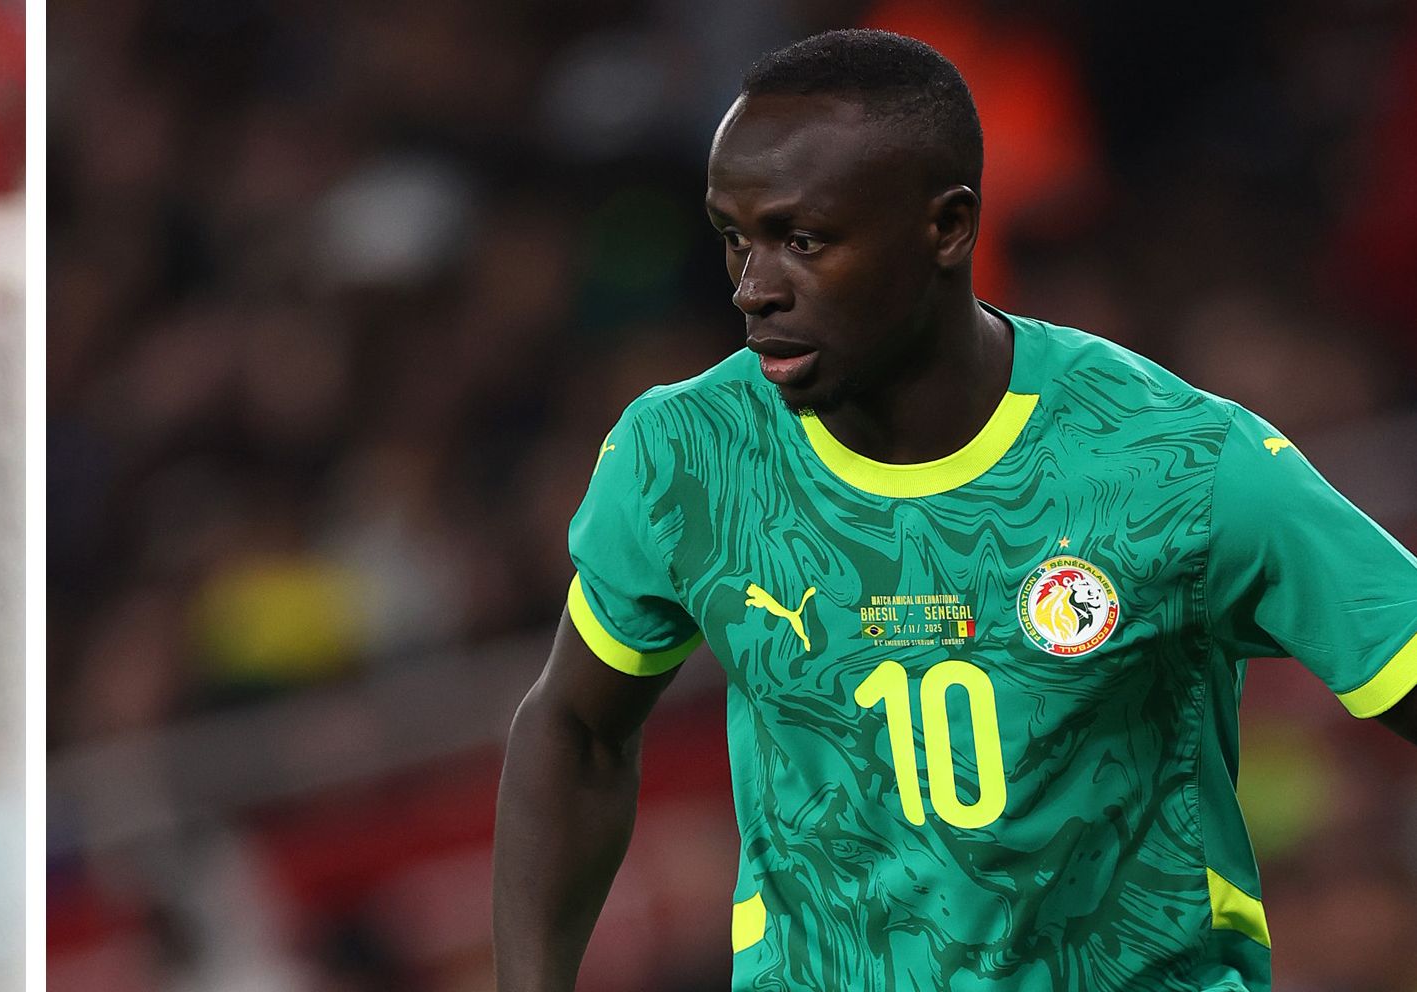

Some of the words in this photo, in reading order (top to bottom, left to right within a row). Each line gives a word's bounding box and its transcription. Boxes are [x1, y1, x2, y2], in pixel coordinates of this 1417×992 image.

[860, 607, 898, 621] BRESIL
[924, 605, 973, 620] SENEGAL
[1107, 611, 1116, 625] DE
[1059, 627, 1110, 653] FOOTBALL
[853, 659, 1008, 829] 10
